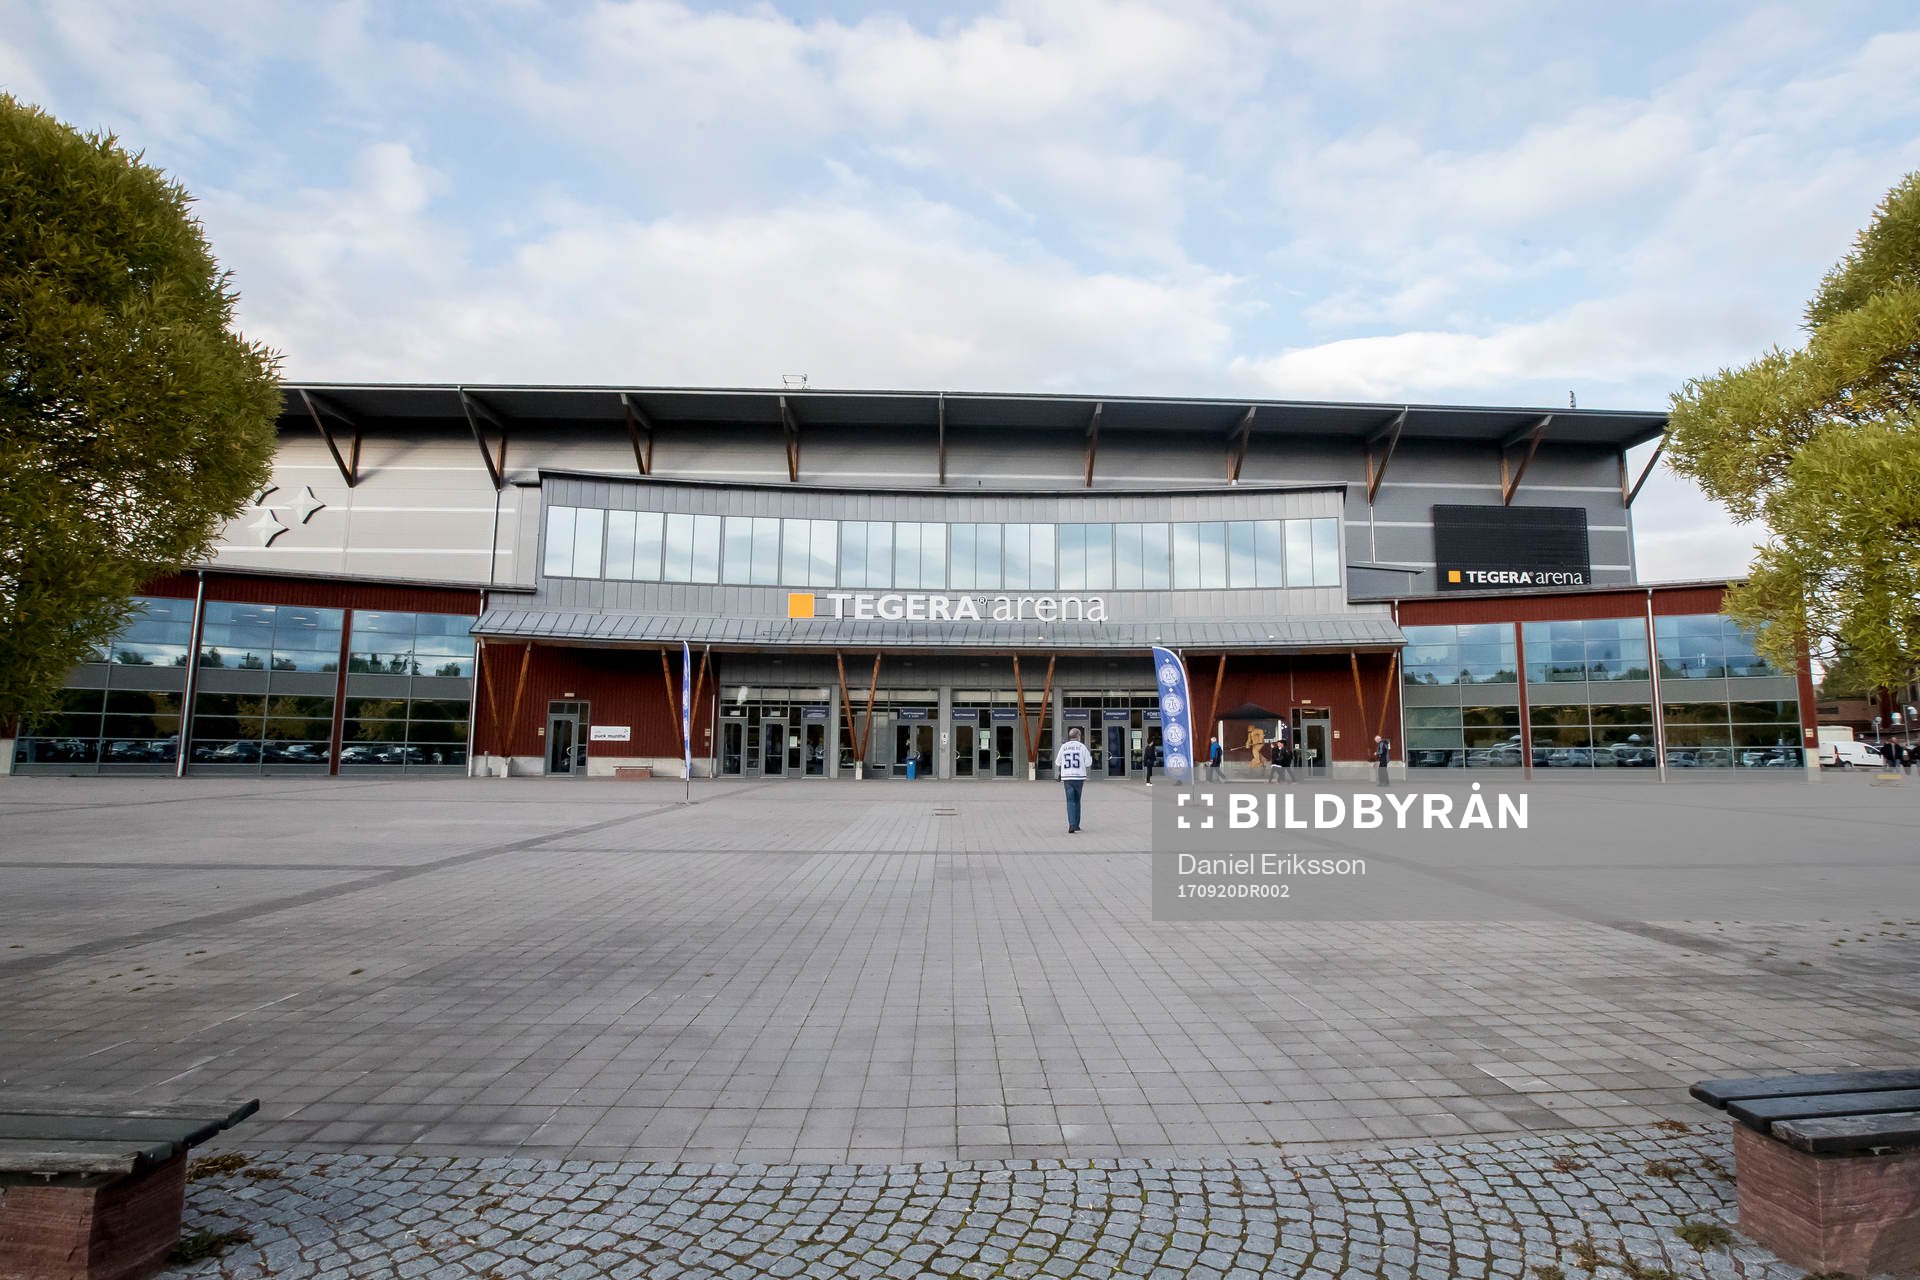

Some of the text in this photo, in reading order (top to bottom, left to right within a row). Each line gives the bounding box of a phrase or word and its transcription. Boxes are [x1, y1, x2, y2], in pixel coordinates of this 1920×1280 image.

[1535, 572, 1584, 585] arena
[992, 595, 1109, 623] arena
[1064, 753, 1080, 769] 55
